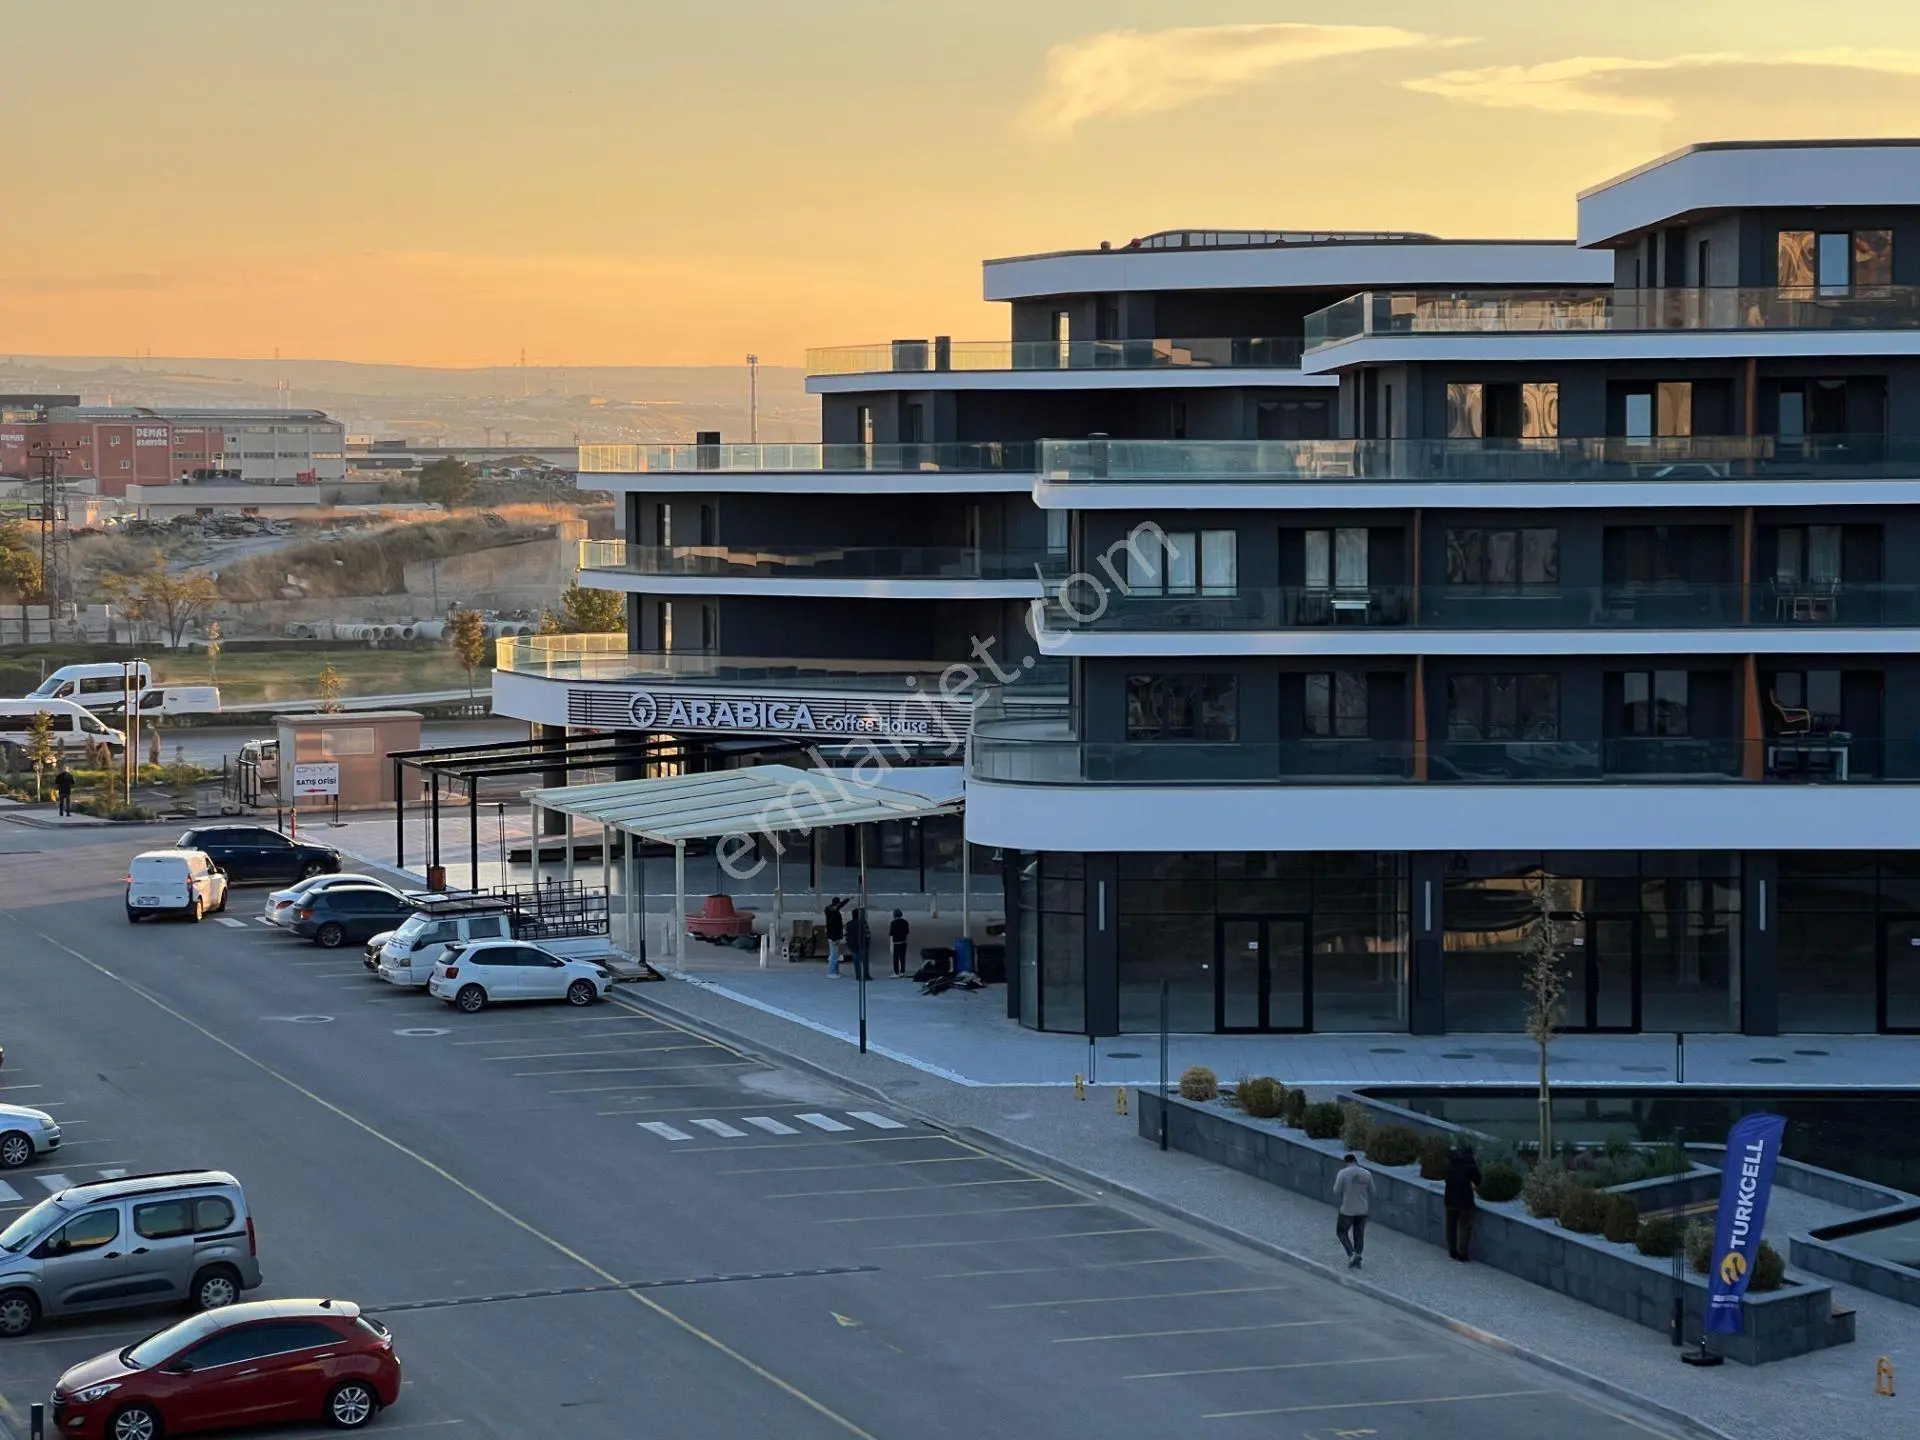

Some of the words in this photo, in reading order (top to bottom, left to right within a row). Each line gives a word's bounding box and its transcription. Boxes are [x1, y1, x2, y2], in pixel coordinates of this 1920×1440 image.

[135, 427, 168, 438] DEMAS
[665, 699, 816, 730] ARABICA
[822, 714, 874, 732] Coffee
[879, 716, 928, 733] House
[1730, 1139, 1764, 1249] TURKCELL
